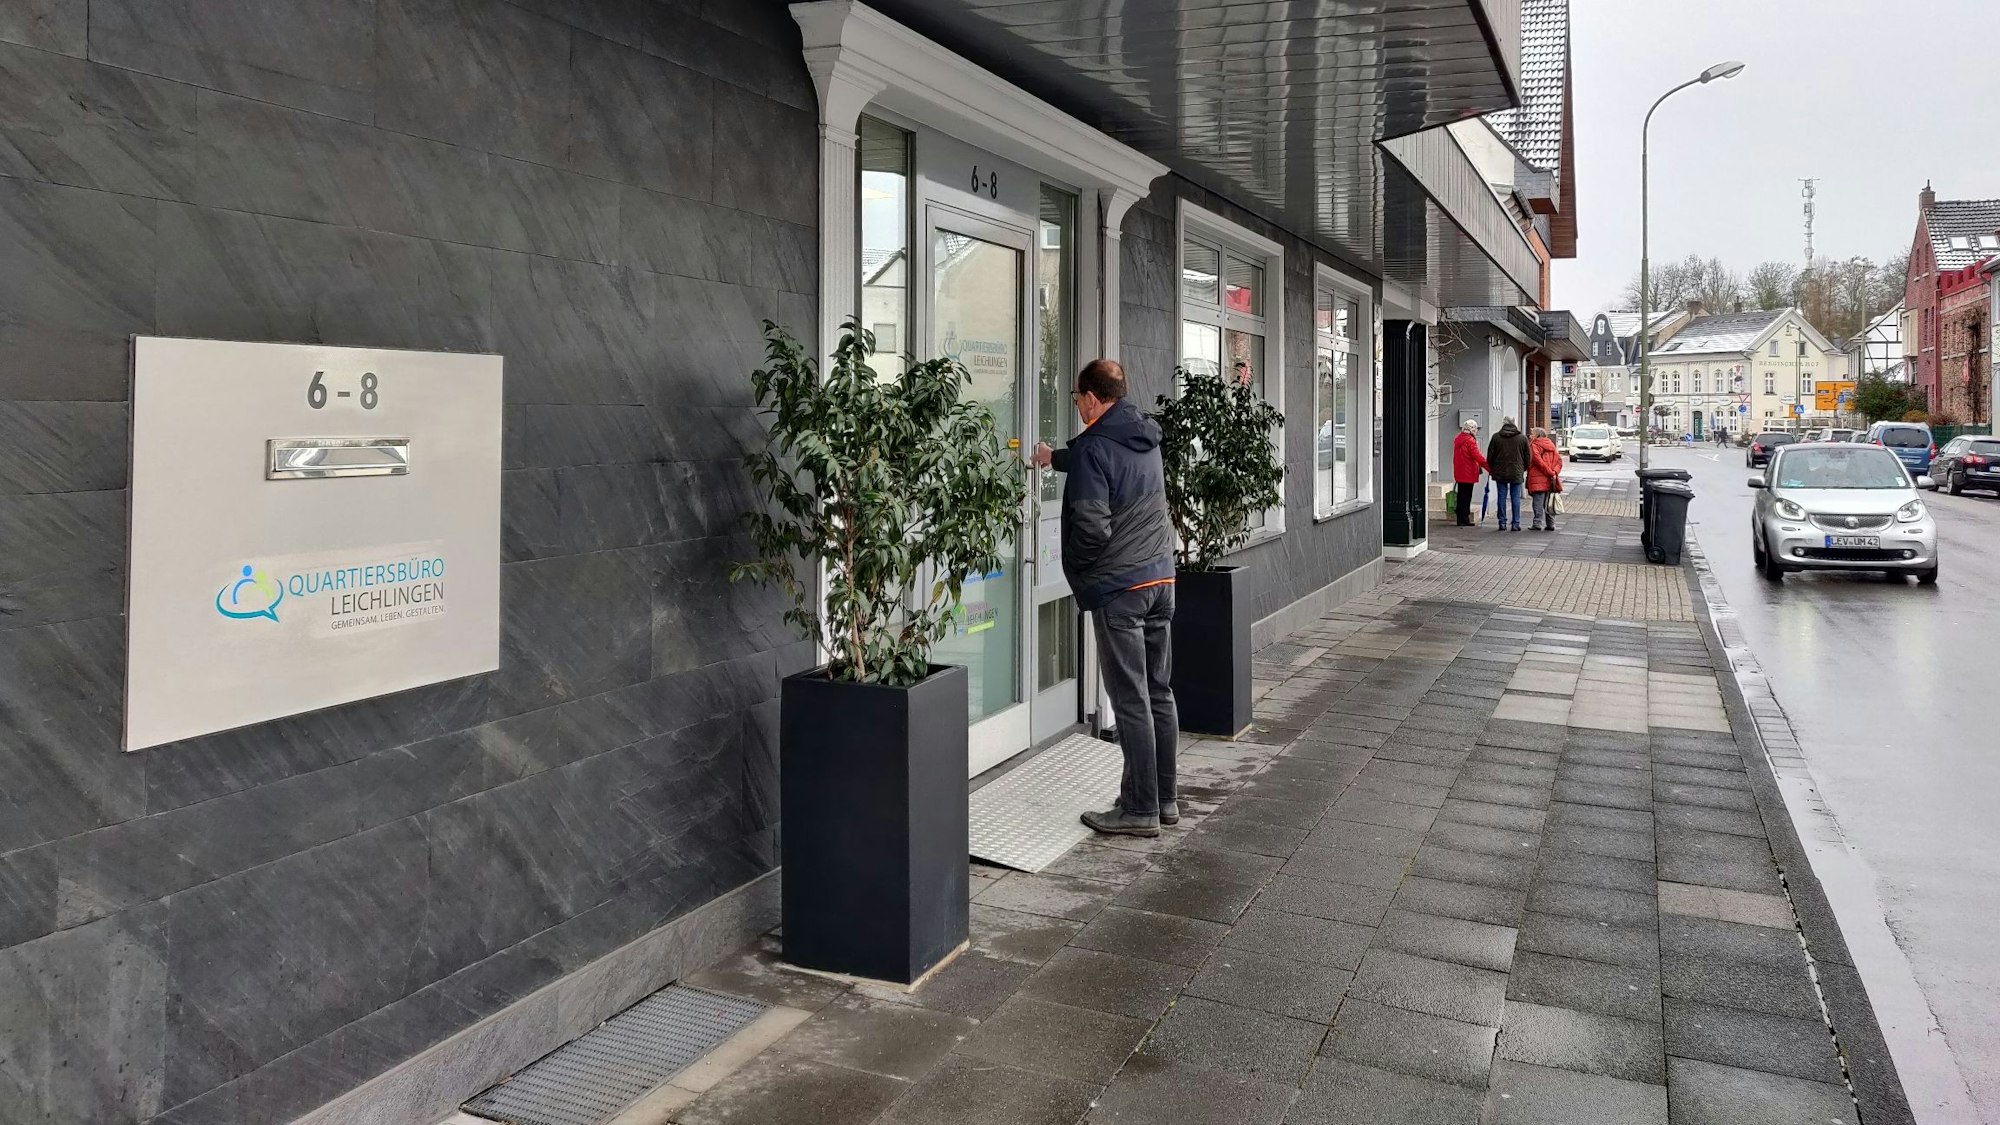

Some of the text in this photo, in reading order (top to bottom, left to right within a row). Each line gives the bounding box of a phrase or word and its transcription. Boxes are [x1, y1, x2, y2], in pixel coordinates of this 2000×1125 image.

[288, 557, 445, 597] QUARTIERSBÜRO
[331, 582, 444, 616] LEICHLINGEN
[331, 605, 444, 630] GEMEINSAM. LEBEN. GESTALTEN
